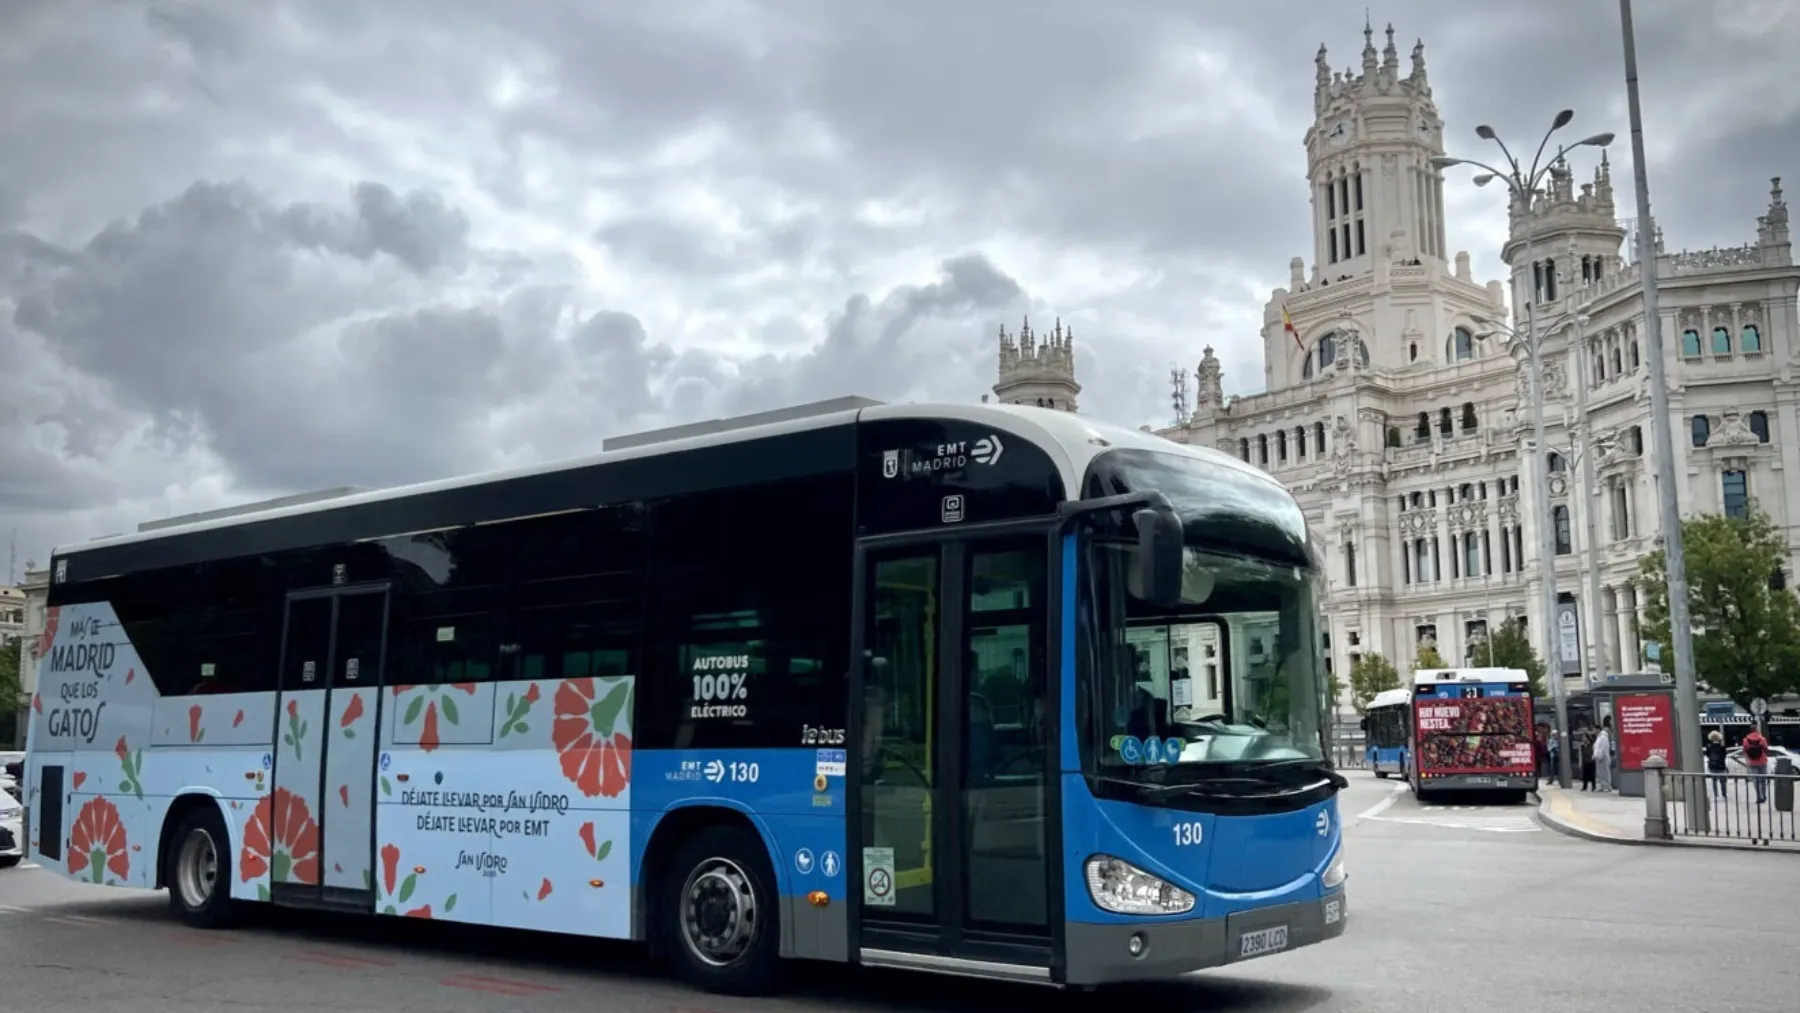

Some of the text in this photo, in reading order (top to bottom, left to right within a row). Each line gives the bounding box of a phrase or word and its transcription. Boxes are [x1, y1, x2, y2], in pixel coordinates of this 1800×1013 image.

[937, 442, 966, 456] EMT
[912, 455, 966, 472] MADRID
[50, 642, 115, 678] MADRID
[693, 655, 749, 670] AUTOBUS
[61, 681, 99, 704] QUE LOS
[692, 673, 747, 700] 100%
[691, 703, 747, 718] ELÉCTRICO
[48, 701, 106, 744] GATOS
[818, 725, 845, 744] bus
[665, 771, 702, 780] MADRID
[681, 761, 702, 770] EMT
[729, 762, 759, 782] 130
[402, 787, 569, 815] DÉJATE LLEVAR POR SAN ISIDRO
[417, 811, 550, 838] DÉJATE LLEVAR POR EMT
[1172, 822, 1203, 846] 130
[455, 850, 507, 873] SAN ISIDRO
[1243, 932, 1266, 953] 2390
